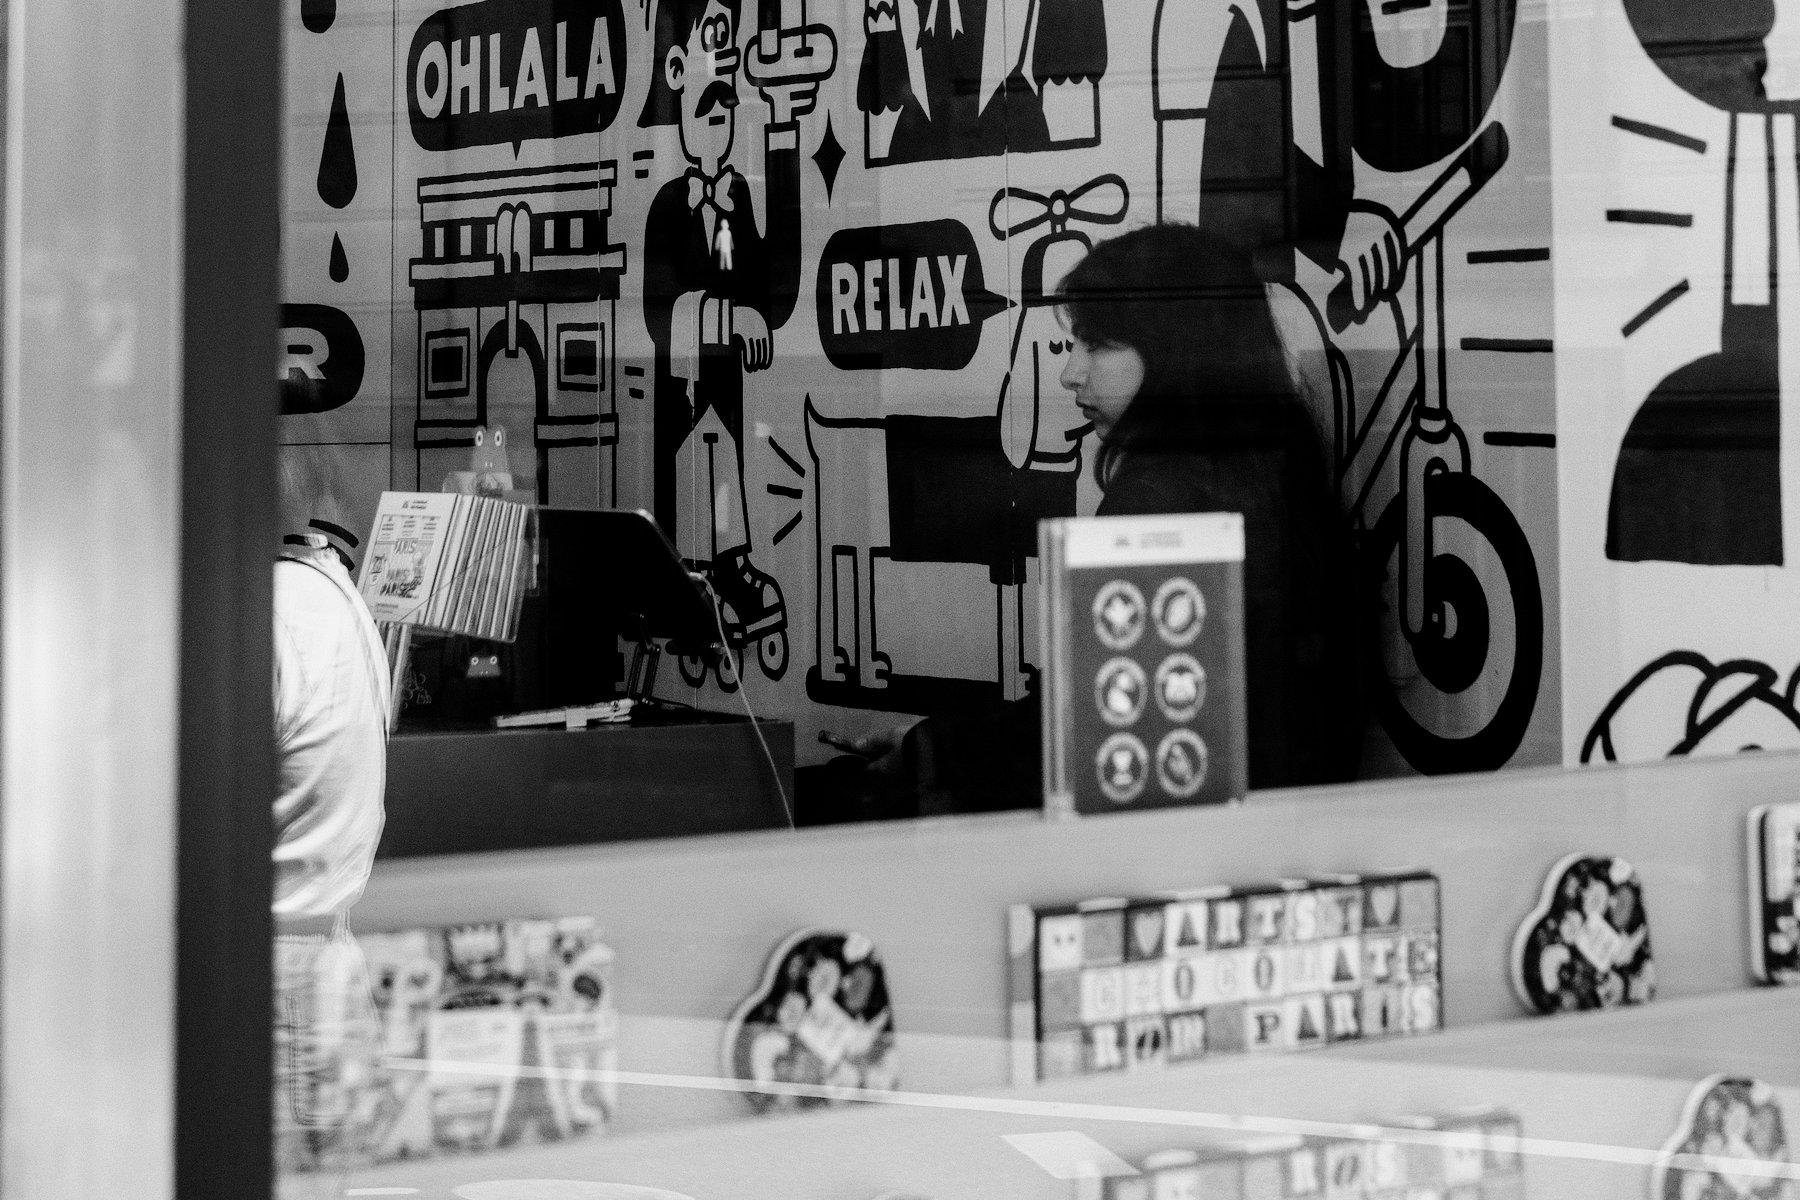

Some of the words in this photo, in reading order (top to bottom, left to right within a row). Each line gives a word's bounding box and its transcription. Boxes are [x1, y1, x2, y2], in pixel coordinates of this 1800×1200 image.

[416, 16, 617, 119] OHLALA
[831, 254, 971, 335] RELAX
[1254, 985, 1437, 1044] PARIS
